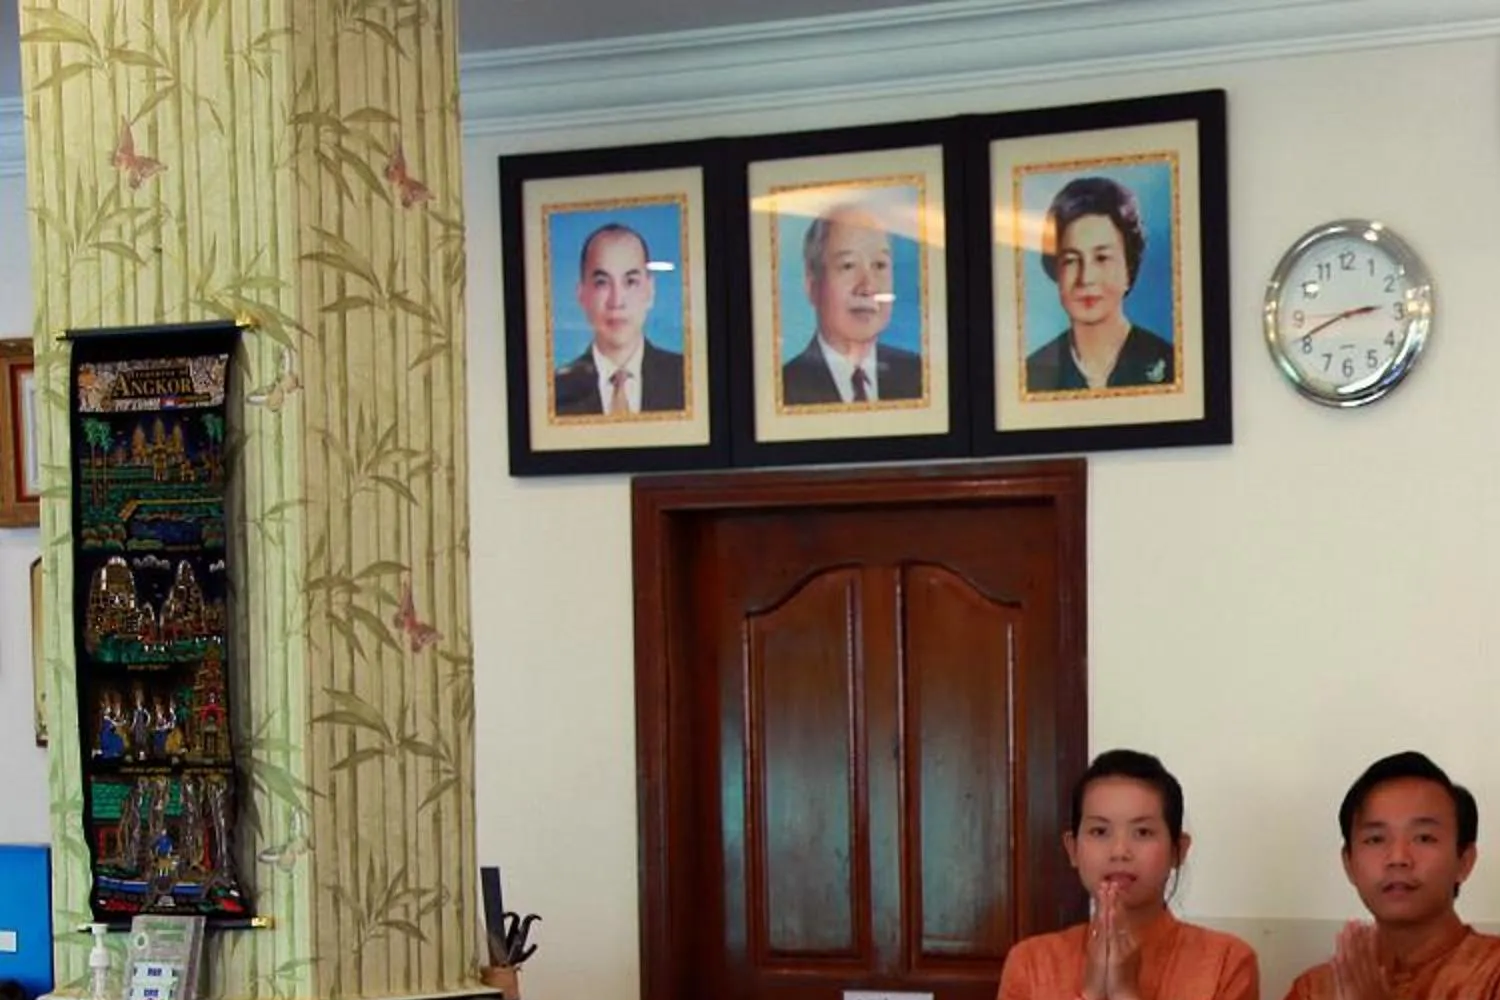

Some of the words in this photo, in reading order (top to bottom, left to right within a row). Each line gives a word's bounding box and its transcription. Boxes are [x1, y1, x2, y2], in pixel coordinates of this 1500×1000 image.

[1338, 251, 1356, 271] 12
[1367, 259, 1375, 277] 1
[1316, 262, 1332, 280] 11
[1383, 275, 1396, 293] 2
[1293, 310, 1305, 328] 9
[1393, 302, 1405, 321] 3
[1302, 335, 1313, 354] 8
[1384, 330, 1395, 349] 4
[1322, 353, 1333, 372] 7
[1342, 357, 1355, 377] 6
[1367, 350, 1379, 368] 5
[113, 372, 194, 398] ANGKOR
